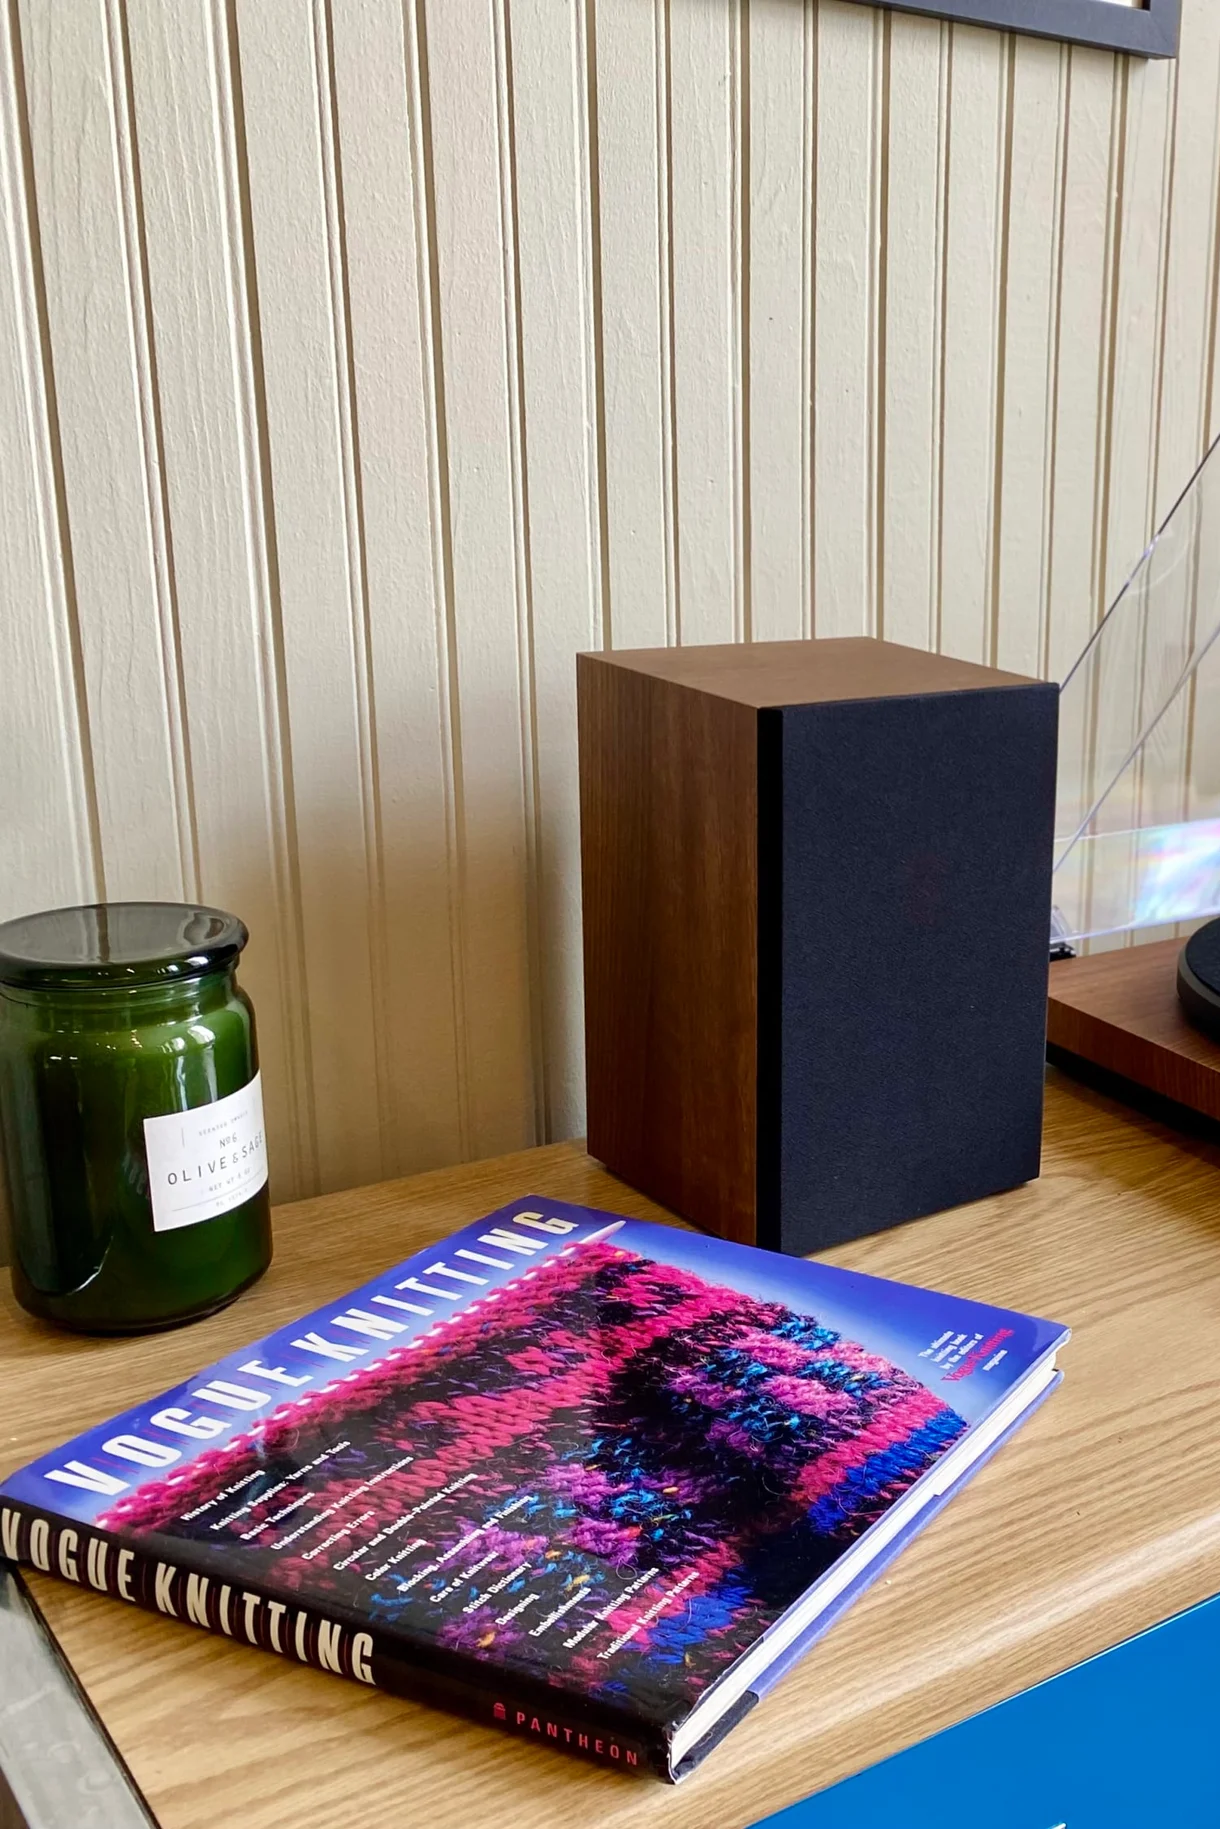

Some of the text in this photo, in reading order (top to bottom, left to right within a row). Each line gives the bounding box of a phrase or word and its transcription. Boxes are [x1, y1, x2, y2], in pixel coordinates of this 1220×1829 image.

[167, 1156, 228, 1185] OLIVE
[232, 1152, 239, 1164] &
[242, 1131, 263, 1158] SAGE
[44, 1211, 579, 1497] VOGUE KNITTING
[180, 1470, 266, 1521] History of Knitting
[210, 1441, 350, 1530] Knitting Supplies: Yarns and Tools
[270, 1456, 414, 1550] Understanding Knitting Instructions
[240, 1492, 315, 1540] Basic Techniques
[302, 1510, 375, 1560] Correcting Errors
[333, 1473, 478, 1570] Circular and Double-Pointed Knitting
[365, 1539, 428, 1581] Color Knitting
[396, 1495, 534, 1592] Blocking, Assembling and Finishing
[1, 1507, 376, 1686] VOGUE KNITTING
[429, 1551, 499, 1603] Care of Knitwear
[462, 1562, 532, 1614] Stitch Dictionary
[495, 1593, 540, 1625] Designing
[528, 1587, 591, 1636] Embellishments
[562, 1567, 660, 1648] Modular Knitting Patterns
[597, 1571, 700, 1660] Traditional Knitting Patterns
[516, 1711, 638, 1766] PANTHEON
